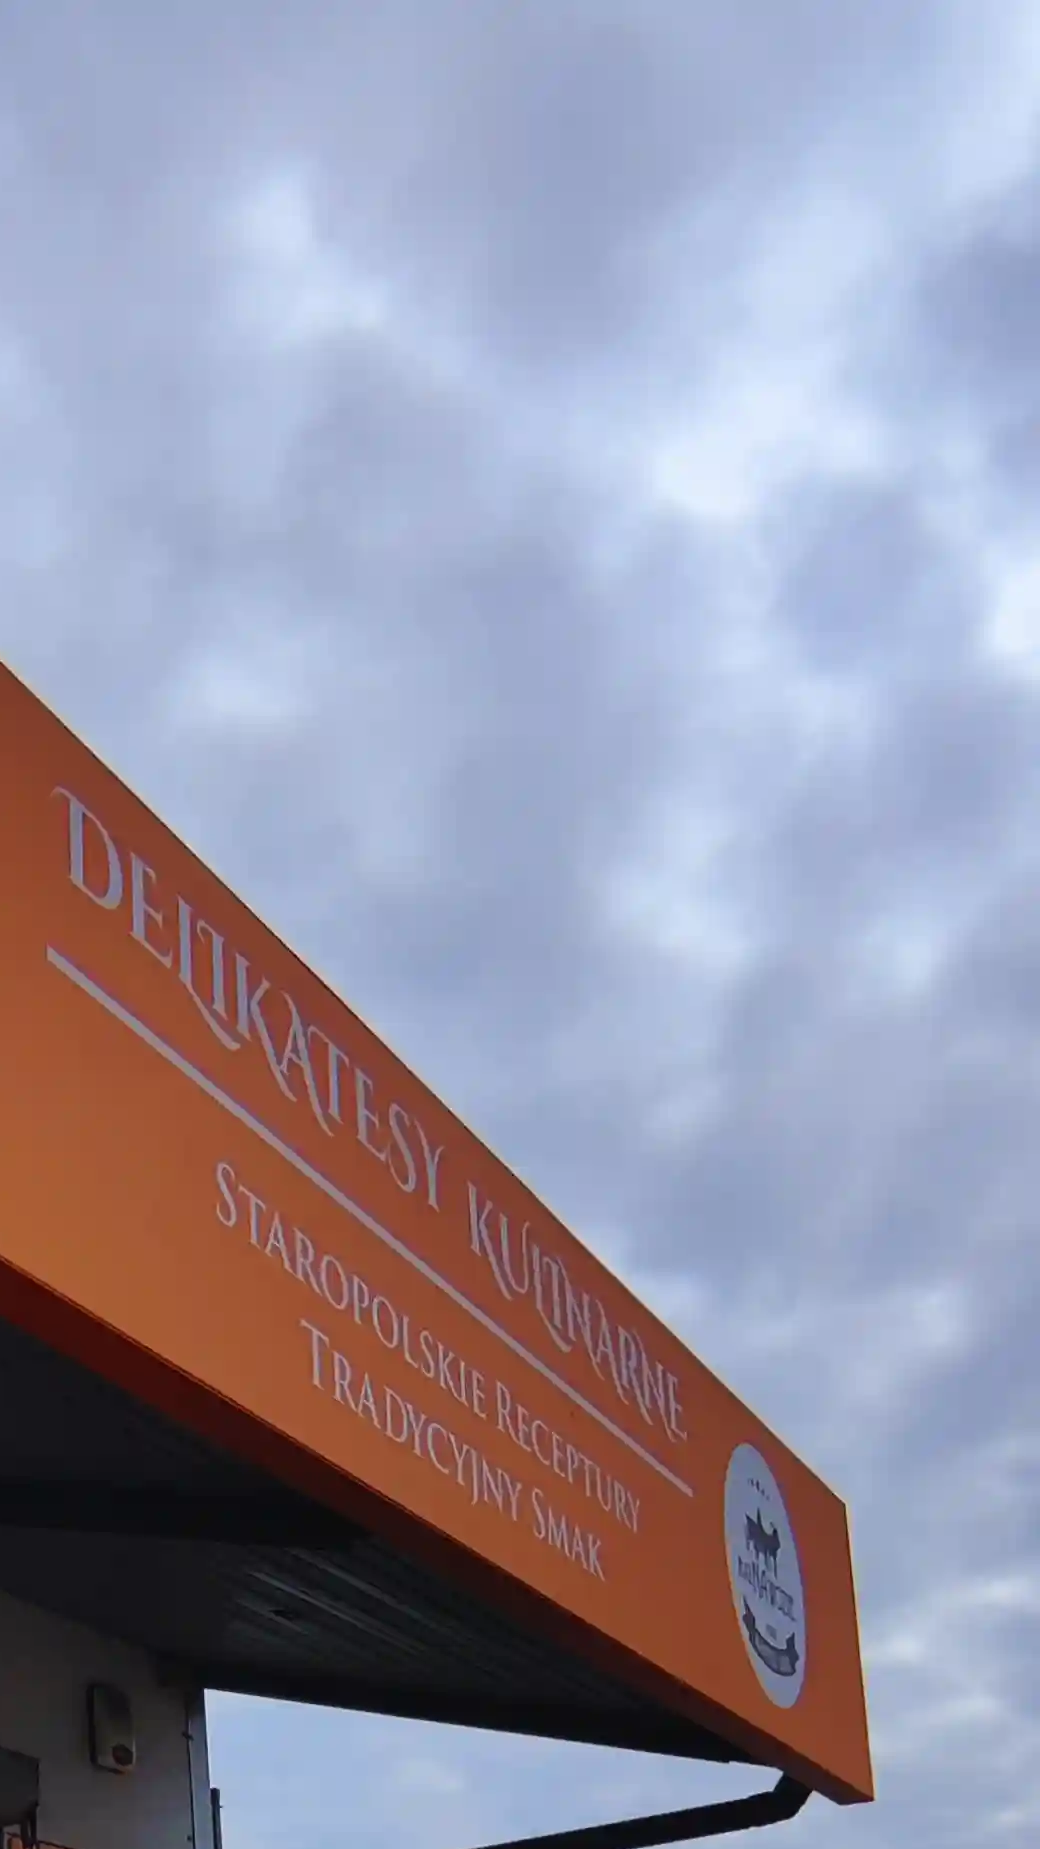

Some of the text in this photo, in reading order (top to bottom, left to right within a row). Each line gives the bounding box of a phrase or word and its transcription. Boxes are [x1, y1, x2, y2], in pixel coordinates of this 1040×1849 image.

[50, 785, 688, 1443] DELIKATESY KULINARNE
[215, 1162, 641, 1534] STAROPOLSKIE RECEPTURY
[299, 1318, 607, 1582] TRADYCYJNY SMAK
